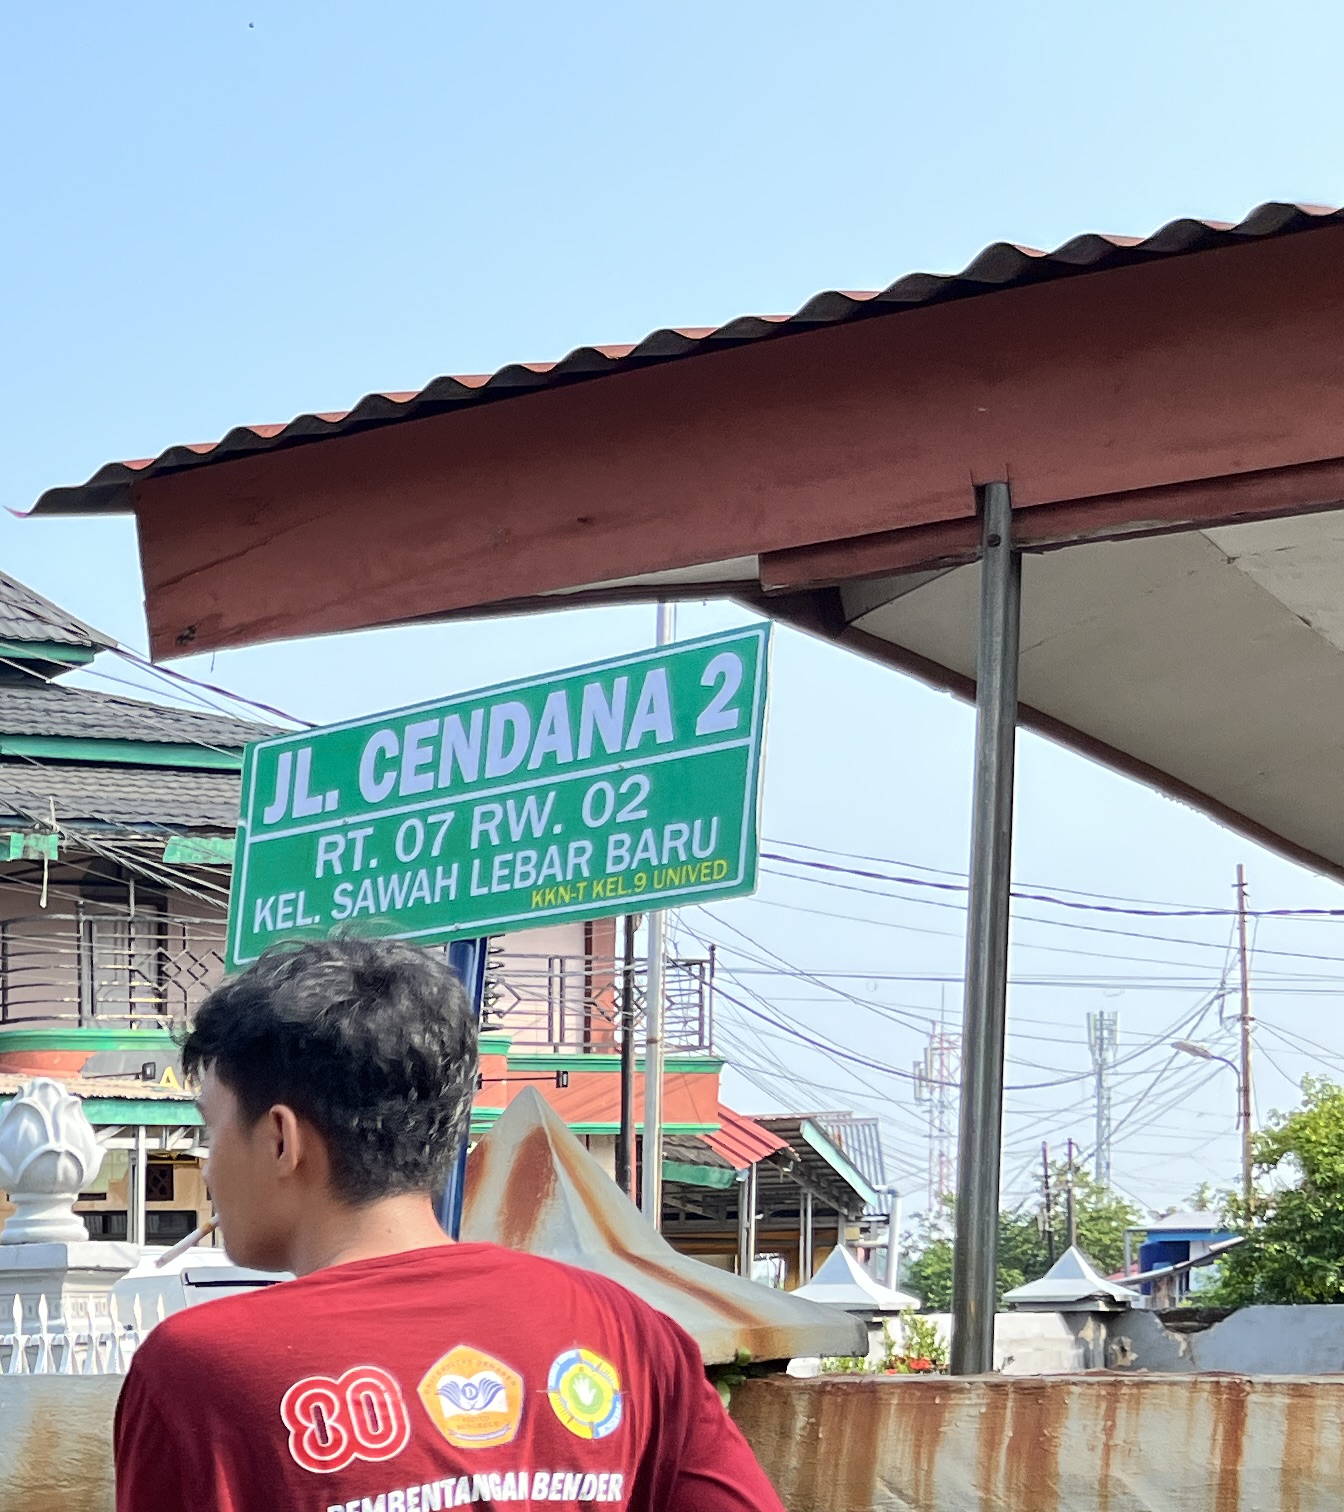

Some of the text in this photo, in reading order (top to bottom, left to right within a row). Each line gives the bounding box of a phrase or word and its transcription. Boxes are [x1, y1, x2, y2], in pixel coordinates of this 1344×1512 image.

[263, 652, 742, 824] JL. CENDANA 2
[253, 816, 718, 934] KEL. SAWAH LEBAR BARU
[315, 774, 650, 879] RT. 07 RW. 02
[531, 881, 587, 909] KKN-T
[653, 858, 728, 889] UNIVED
[280, 1365, 411, 1473] 80
